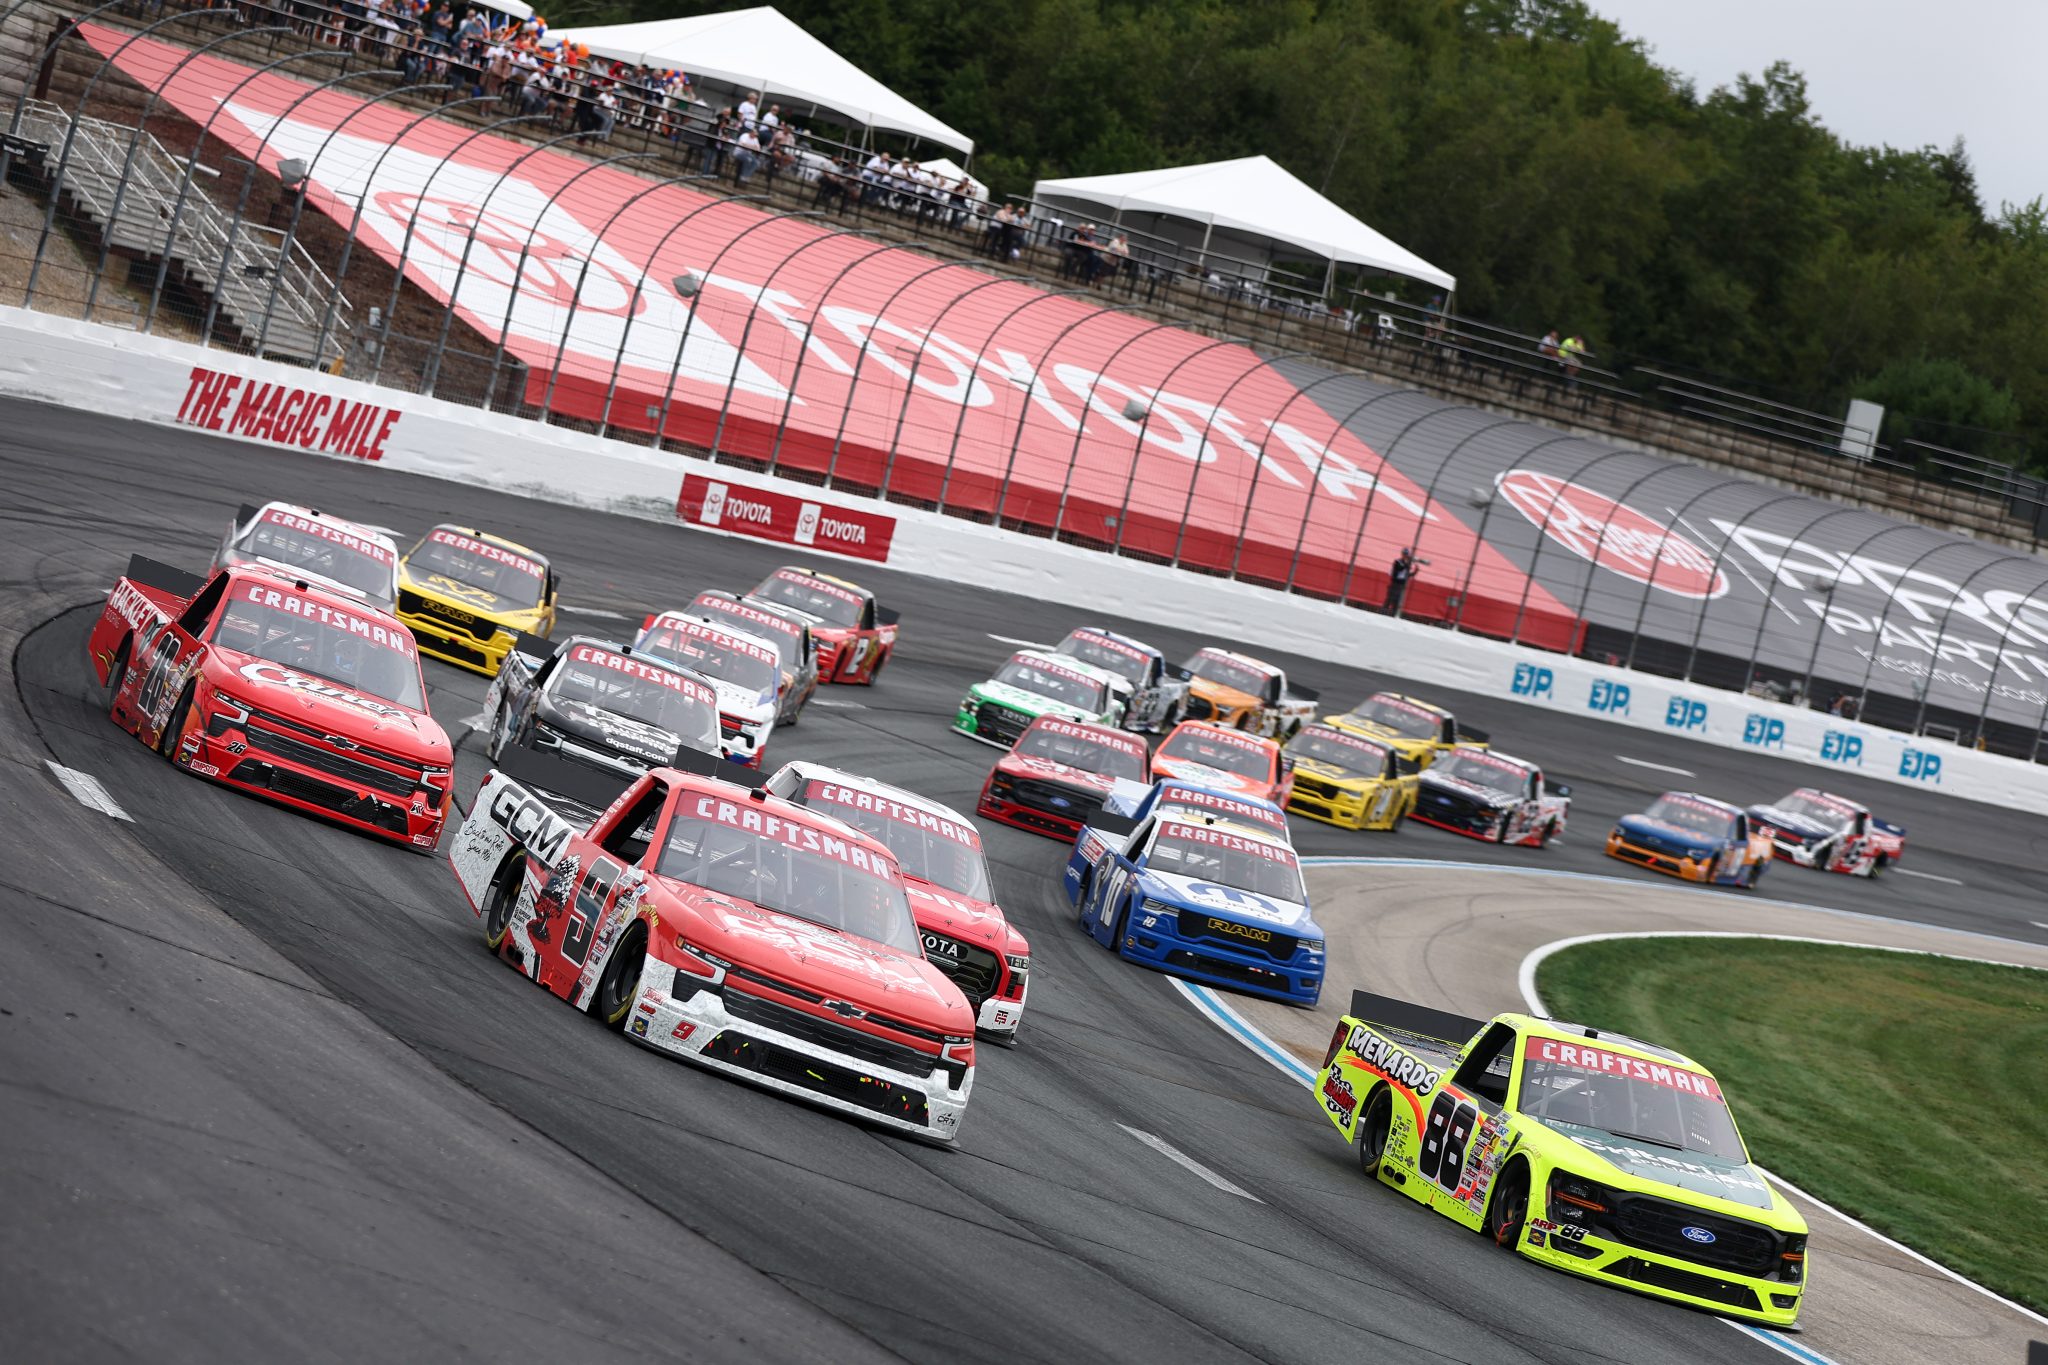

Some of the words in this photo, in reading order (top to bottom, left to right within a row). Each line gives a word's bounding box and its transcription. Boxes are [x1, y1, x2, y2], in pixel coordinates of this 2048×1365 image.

[687, 266, 1440, 521] TOYOTA
[176, 367, 242, 441] THE
[227, 380, 331, 448] MAGIC
[320, 399, 402, 461] MILE
[726, 498, 772, 525] TOYOTA
[271, 512, 385, 561] CRAFTSMAN
[820, 517, 866, 545] TOYOTA
[433, 530, 540, 578] CRAFTSMAN
[778, 570, 855, 603] CRAFTSMAN
[110, 583, 157, 633] RACKLEY
[249, 585, 405, 653] CRAFTSMAN
[422, 599, 475, 625] RAM
[702, 596, 792, 633] CRAFTSMAN
[663, 617, 774, 664] CRAFTSMAN
[1073, 630, 1142, 660] CRAFTSMAN
[577, 648, 712, 704] CRAFTSMAN
[1018, 653, 1097, 688] CRAFTSMAN
[226, 741, 248, 756] 26
[605, 737, 669, 763] dqstaff.com
[1040, 719, 1134, 754] CRAFTSMAN
[1182, 726, 1265, 755] CRAFTSMAN
[1304, 727, 1385, 757] CRAFTSMAN
[192, 759, 219, 776] SIMPSON
[490, 784, 569, 862] GCM
[821, 785, 971, 846] CRAFTSMAN
[1170, 788, 1276, 823] CRAFTSMAN
[696, 797, 891, 881] CRAFTSMAN
[1168, 824, 1287, 864] CRAFTSMAN
[561, 855, 622, 968] 9
[1100, 866, 1128, 926] 10
[1143, 916, 1158, 928] 10
[1208, 917, 1271, 943] RAM
[671, 1020, 697, 1041] 9
[1347, 1025, 1439, 1096] MENARDS
[1541, 1041, 1710, 1098] CRAFTSMAN
[1418, 1091, 1479, 1192] 88
[1531, 1217, 1557, 1231] ARP
[1560, 1224, 1589, 1242] 88
[1683, 1227, 1715, 1243] Ford
